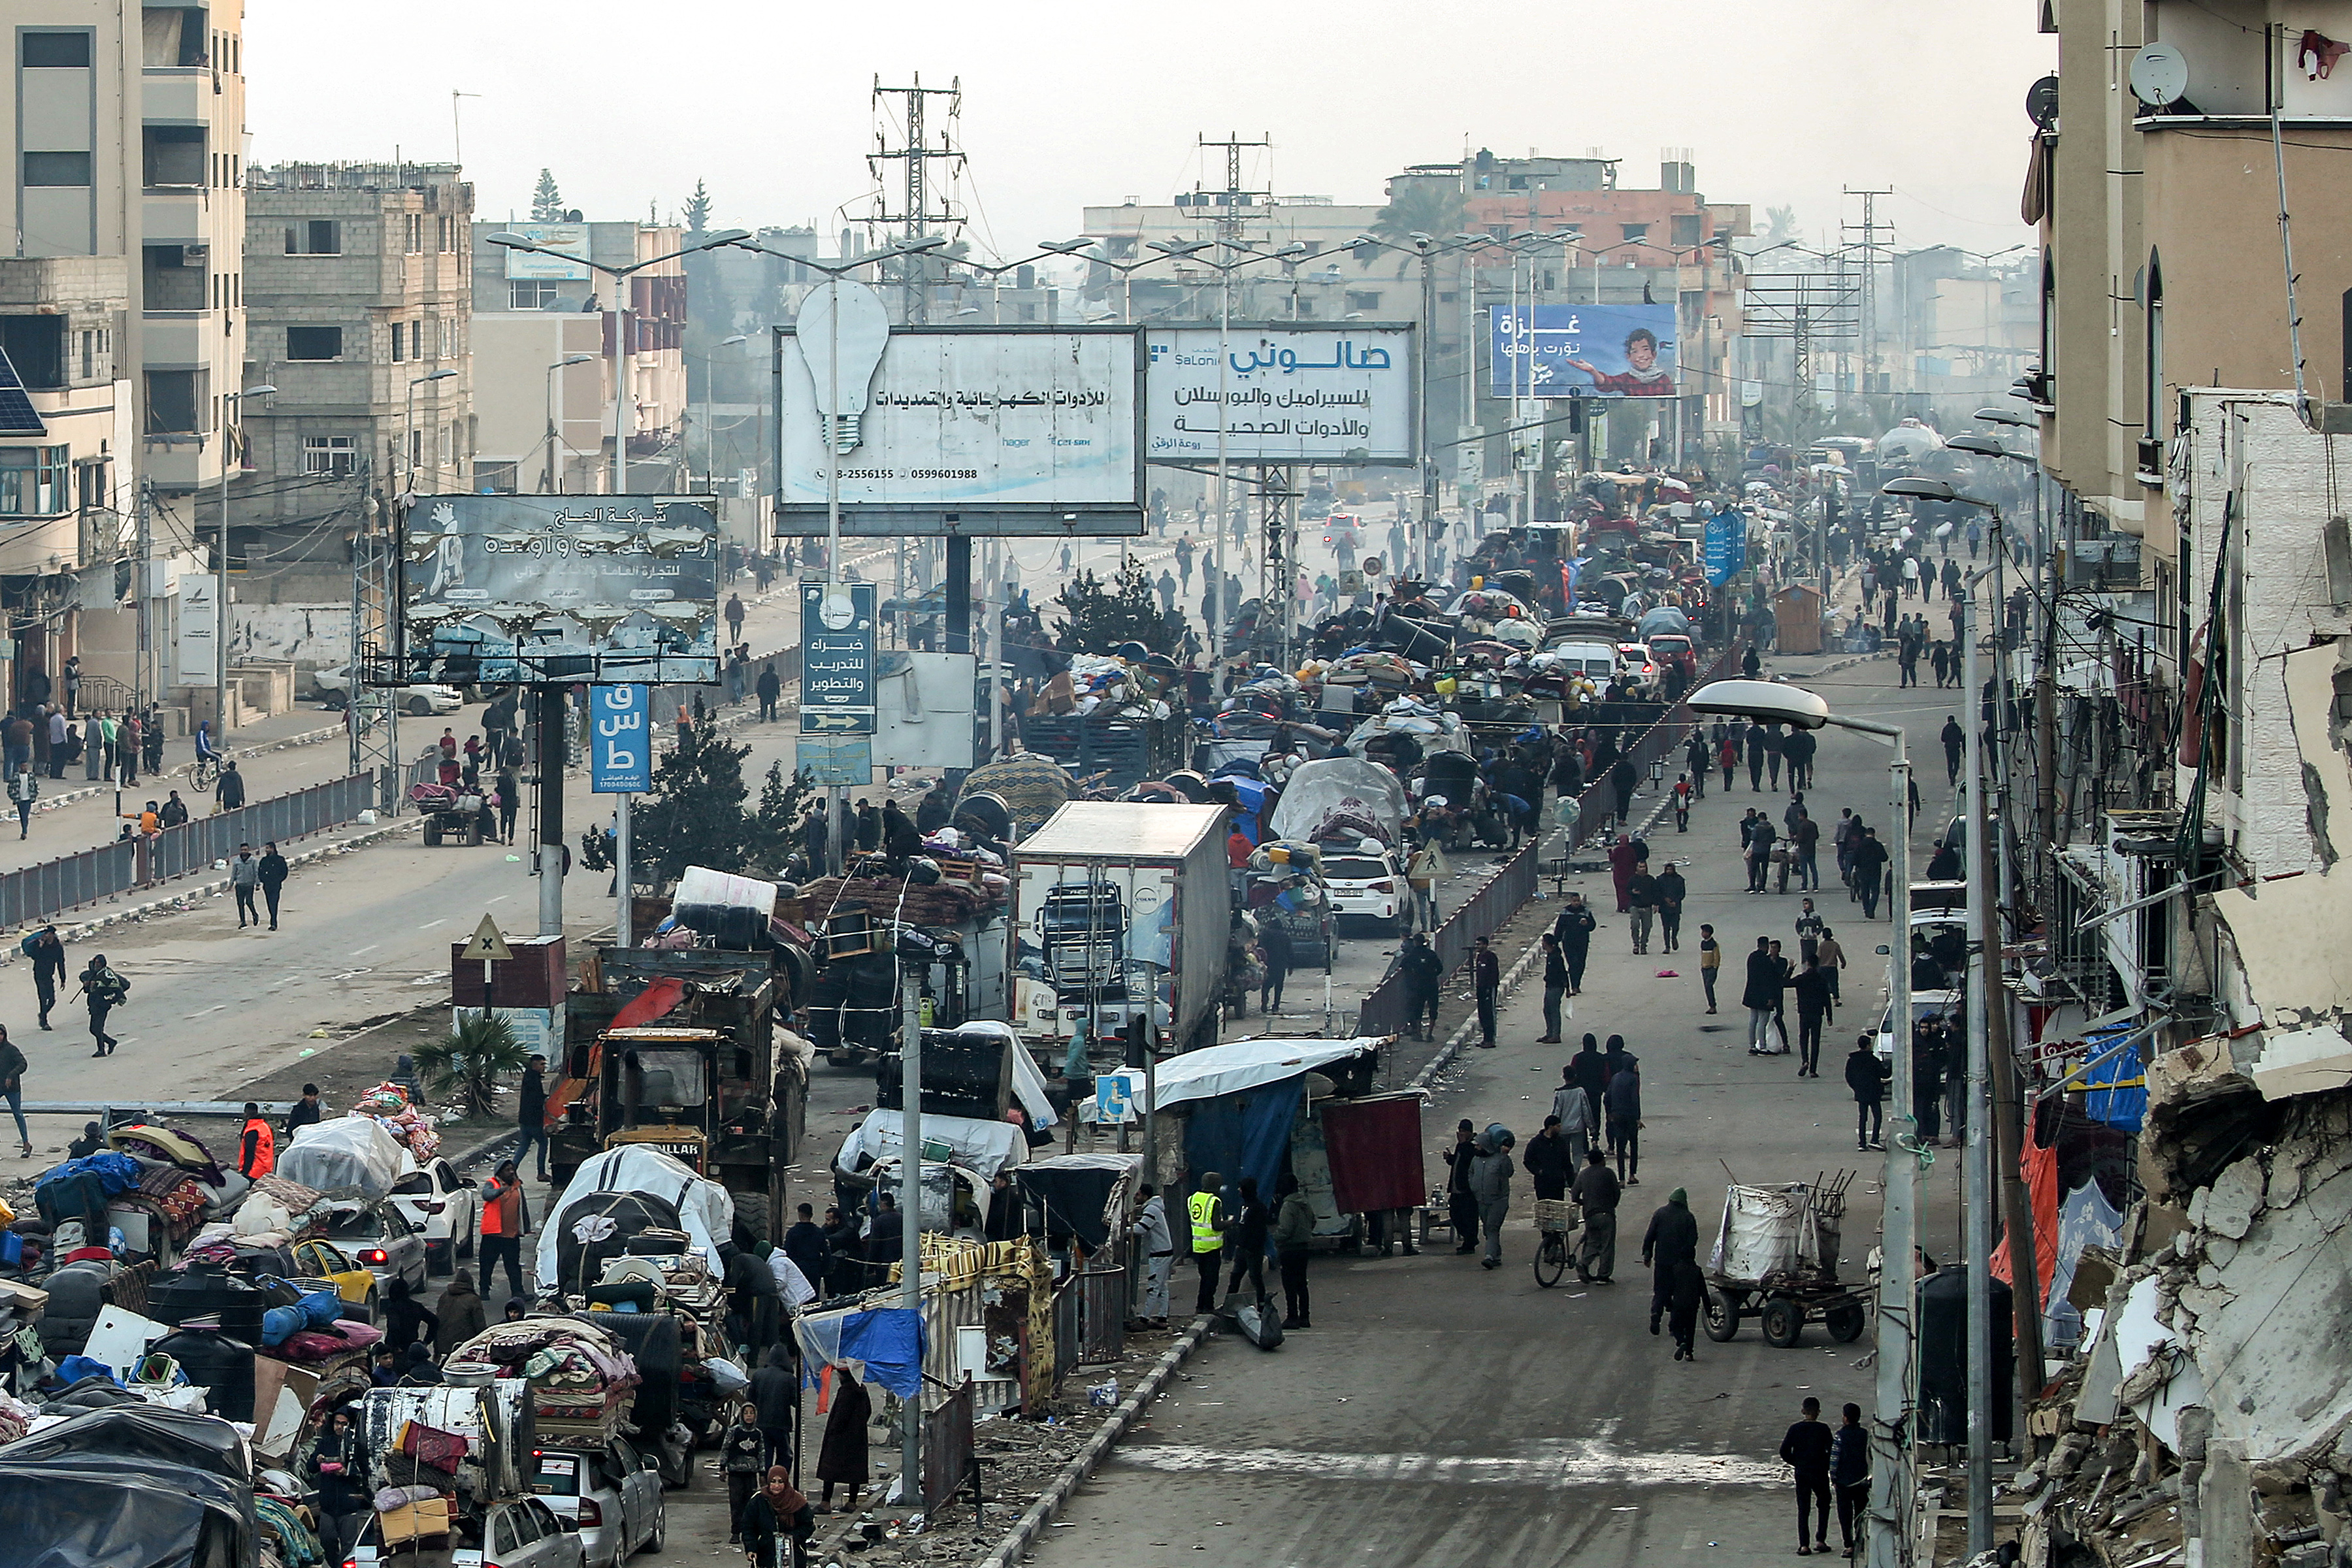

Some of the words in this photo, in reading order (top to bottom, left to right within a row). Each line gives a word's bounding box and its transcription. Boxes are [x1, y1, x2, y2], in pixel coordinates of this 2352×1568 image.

[1500, 314, 1580, 339] غزة
[1230, 340, 1390, 378] صالوني
[1054, 387, 1105, 410] للأدوات
[1174, 386, 1271, 406] والبورسلان
[1276, 388, 1369, 408] للسيراميك
[1173, 414, 1290, 437] الصحية
[1294, 417, 1369, 438] والأدوات
[1002, 438, 1030, 448] hager
[1178, 438, 1201, 450] روعة
[837, 469, 894, 479] 8-2556155
[911, 469, 978, 479] 0599601988
[554, 508, 603, 528] الحاج
[607, 507, 667, 527] شركة
[600, 564, 638, 576] العامة
[641, 564, 680, 580] للتجارة
[811, 638, 864, 653] خبراء
[809, 658, 864, 672] للتدريب
[810, 678, 864, 692] والتطوير
